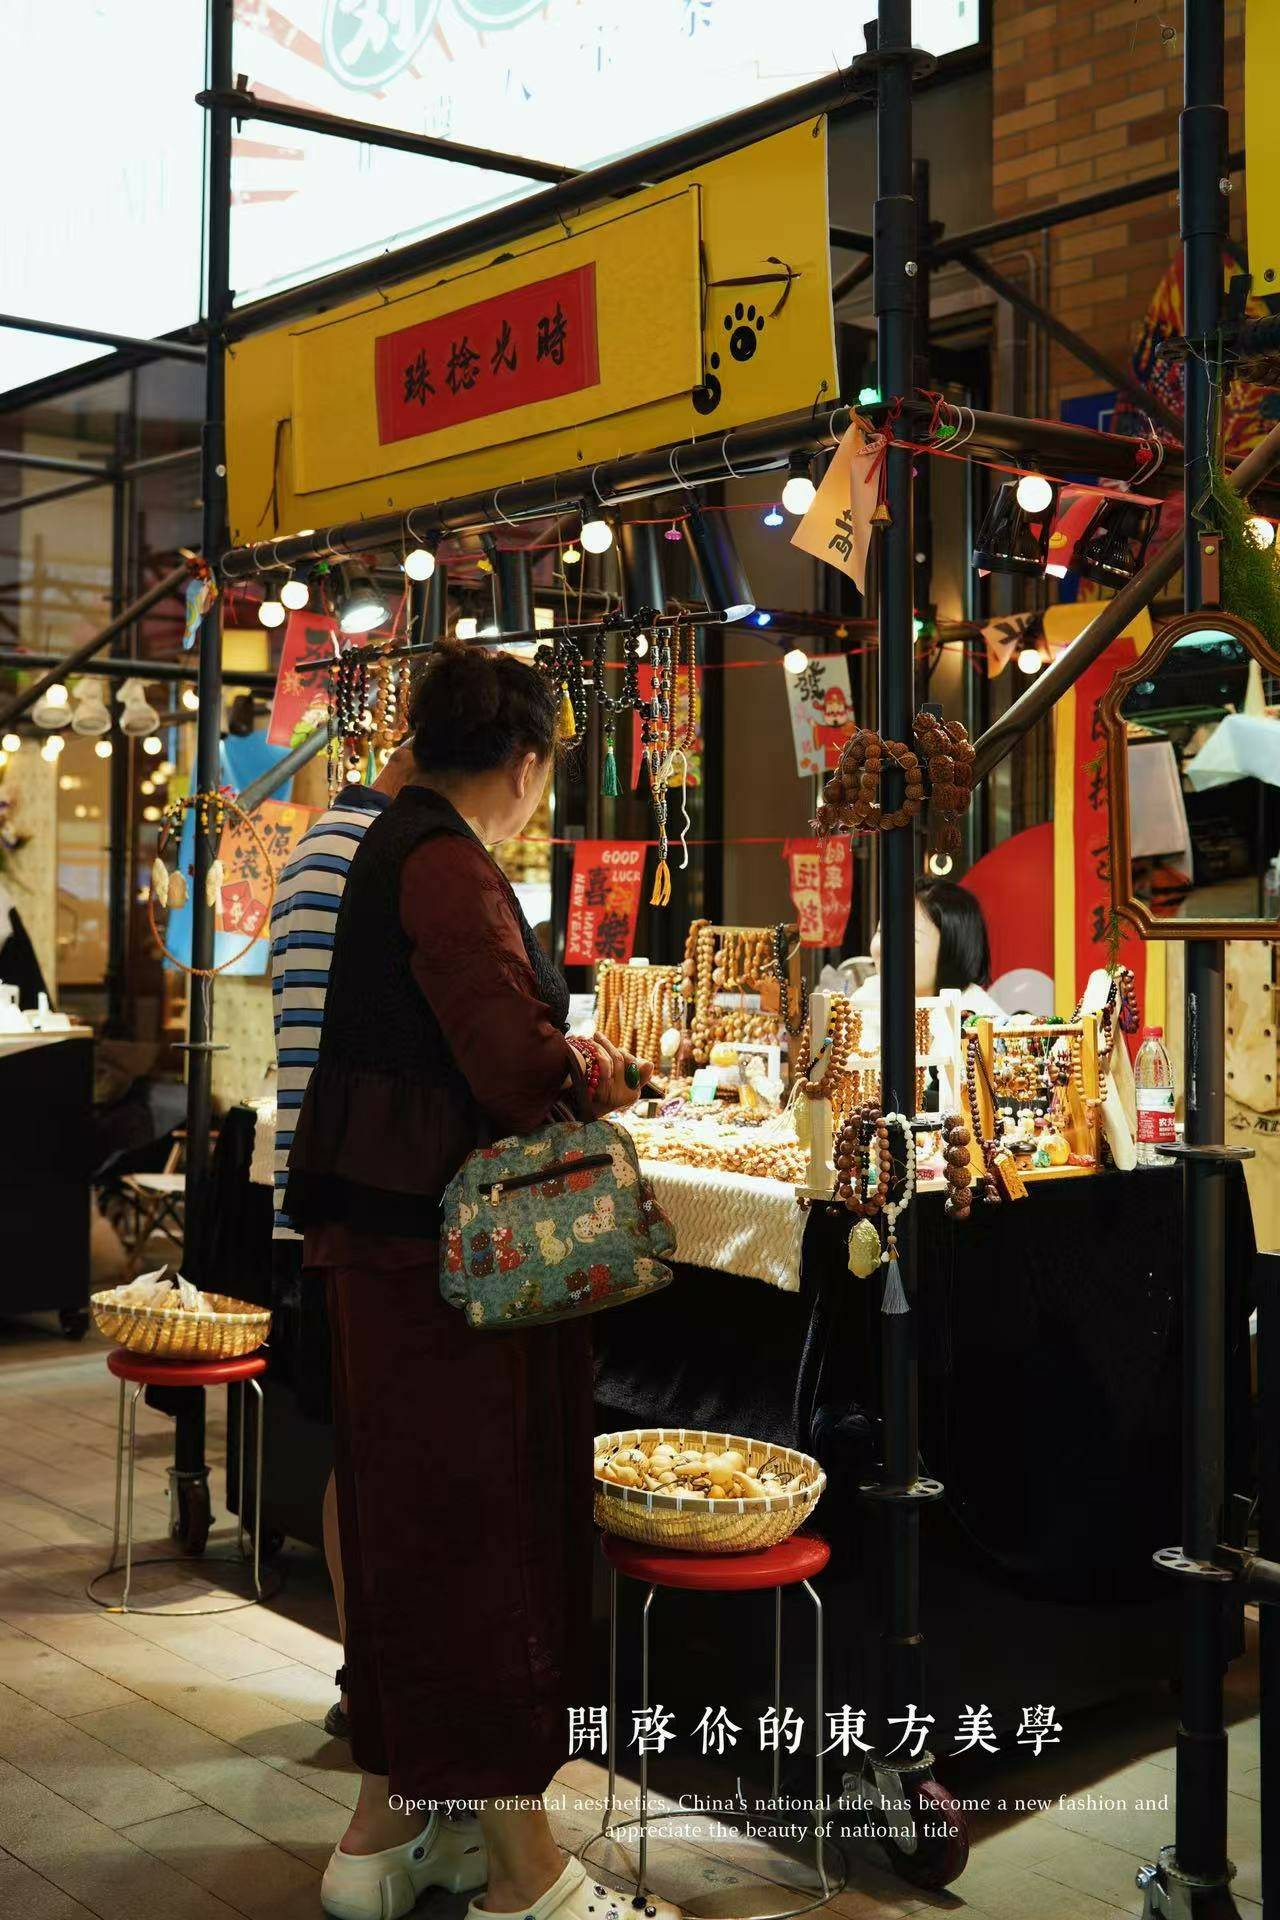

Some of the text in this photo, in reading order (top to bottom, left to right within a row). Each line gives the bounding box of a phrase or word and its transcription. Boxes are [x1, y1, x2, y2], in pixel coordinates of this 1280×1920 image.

[601, 850, 640, 864] GOOD
[611, 869, 641, 882] LUCK
[569, 873, 585, 953] NEW YEAR
[582, 911, 595, 958] HAPPY
